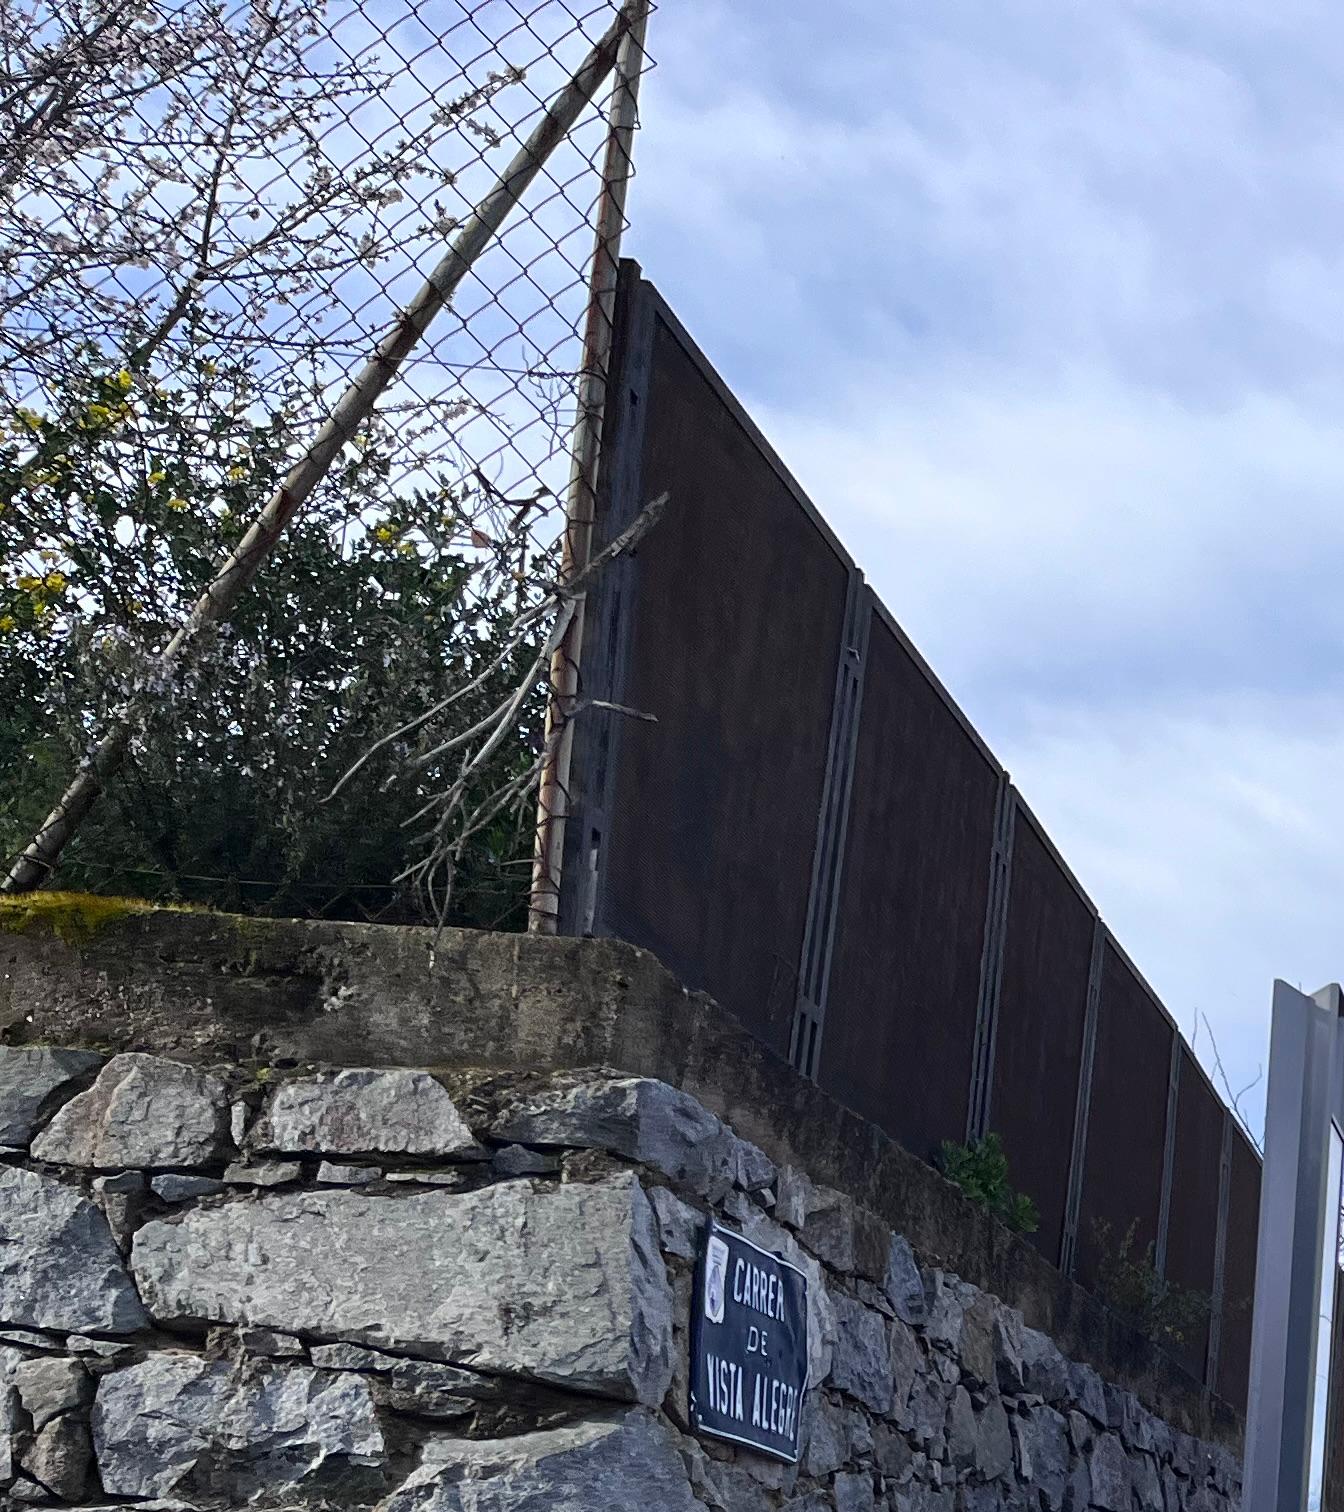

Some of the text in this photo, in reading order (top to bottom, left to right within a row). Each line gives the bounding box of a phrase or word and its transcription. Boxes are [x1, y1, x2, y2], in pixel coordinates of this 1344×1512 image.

[732, 1256, 786, 1323] CARRER
[746, 1326, 768, 1356] DE
[706, 1353, 799, 1442] VISTA ALEGRE
